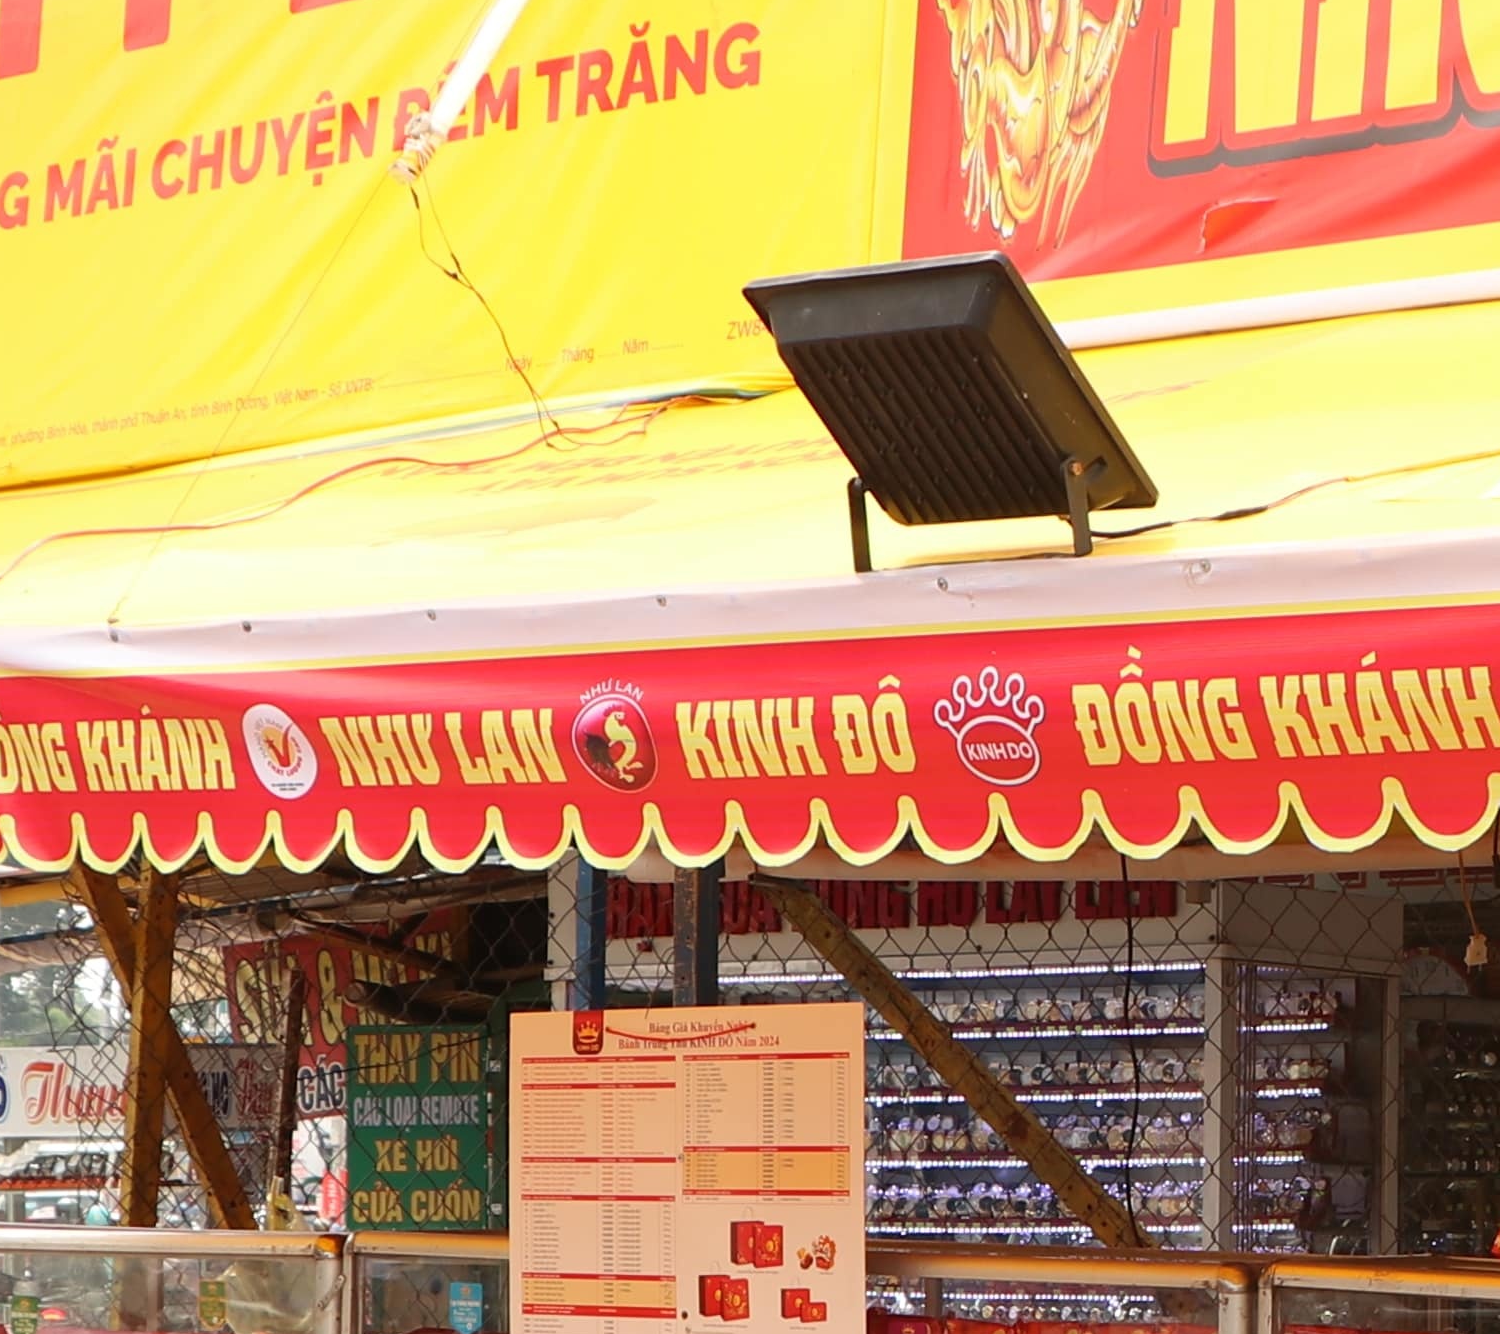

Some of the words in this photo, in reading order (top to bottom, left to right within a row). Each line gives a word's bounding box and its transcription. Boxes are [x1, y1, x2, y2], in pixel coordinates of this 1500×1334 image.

[44, 138, 137, 219] MÃI
[150, 89, 382, 203] CHUYỆN
[535, 21, 763, 124] TRĂNG
[622, 338, 649, 355] Năm
[615, 678, 644, 701] LAN
[1071, 644, 1258, 767] ĐỒNG
[75, 703, 237, 793] KHÁNH
[320, 712, 443, 788] NHƯ
[443, 707, 568, 786] LAN
[674, 695, 829, 780] KINH
[831, 673, 918, 775] ĐÔ
[648, 1021, 671, 1036] Bảng
[671, 1020, 688, 1035] Giá
[688, 1035, 717, 1050] KINH
[717, 1033, 735, 1048] ĐÔ
[735, 1034, 758, 1048] Năm
[758, 1034, 781, 1048] 2024
[297, 1053, 346, 1113] CÁC
[353, 1032, 422, 1085] THAY
[430, 1031, 481, 1083] PIN
[352, 1090, 382, 1127] CÁC
[421, 1094, 480, 1126] REMOTE
[375, 1140, 408, 1172] XE
[352, 1179, 403, 1225] CỬA
[410, 1178, 481, 1223] CUỐN
